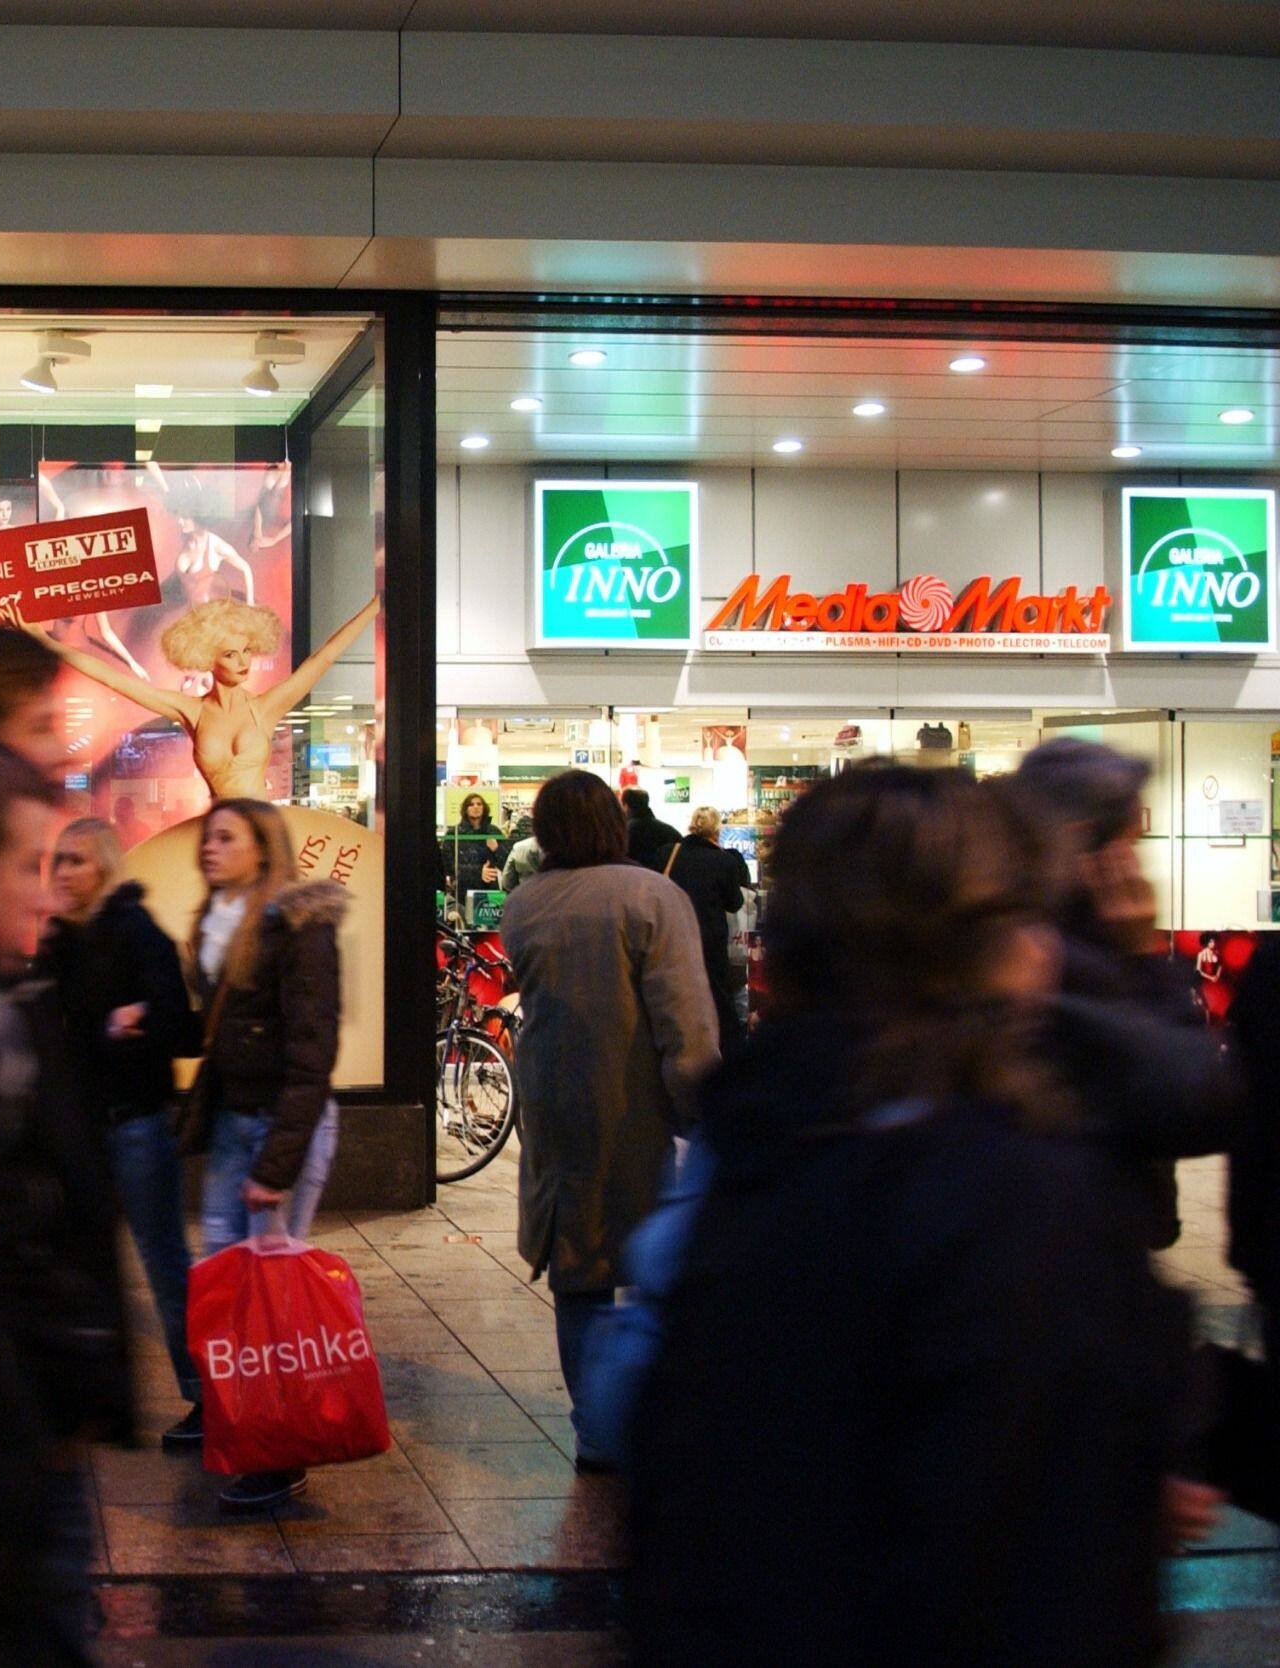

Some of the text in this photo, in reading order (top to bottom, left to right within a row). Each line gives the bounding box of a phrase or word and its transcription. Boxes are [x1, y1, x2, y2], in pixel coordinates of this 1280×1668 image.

[28, 529, 133, 565] LE VIF
[34, 570, 154, 599] PRECIOSA
[67, 588, 125, 602] JEWELRY
[565, 566, 681, 602] INNO
[1150, 571, 1260, 608] INNO
[706, 573, 1112, 633] Media Markt
[825, 637, 871, 647] PLASMA
[878, 637, 900, 647] HIFI
[906, 637, 922, 647] CD
[929, 637, 952, 647] DVD
[959, 638, 995, 648] PHOTO
[1003, 638, 1050, 648] ELECTRO
[1058, 638, 1106, 648] TELECOM
[206, 1325, 370, 1380] Bershka
